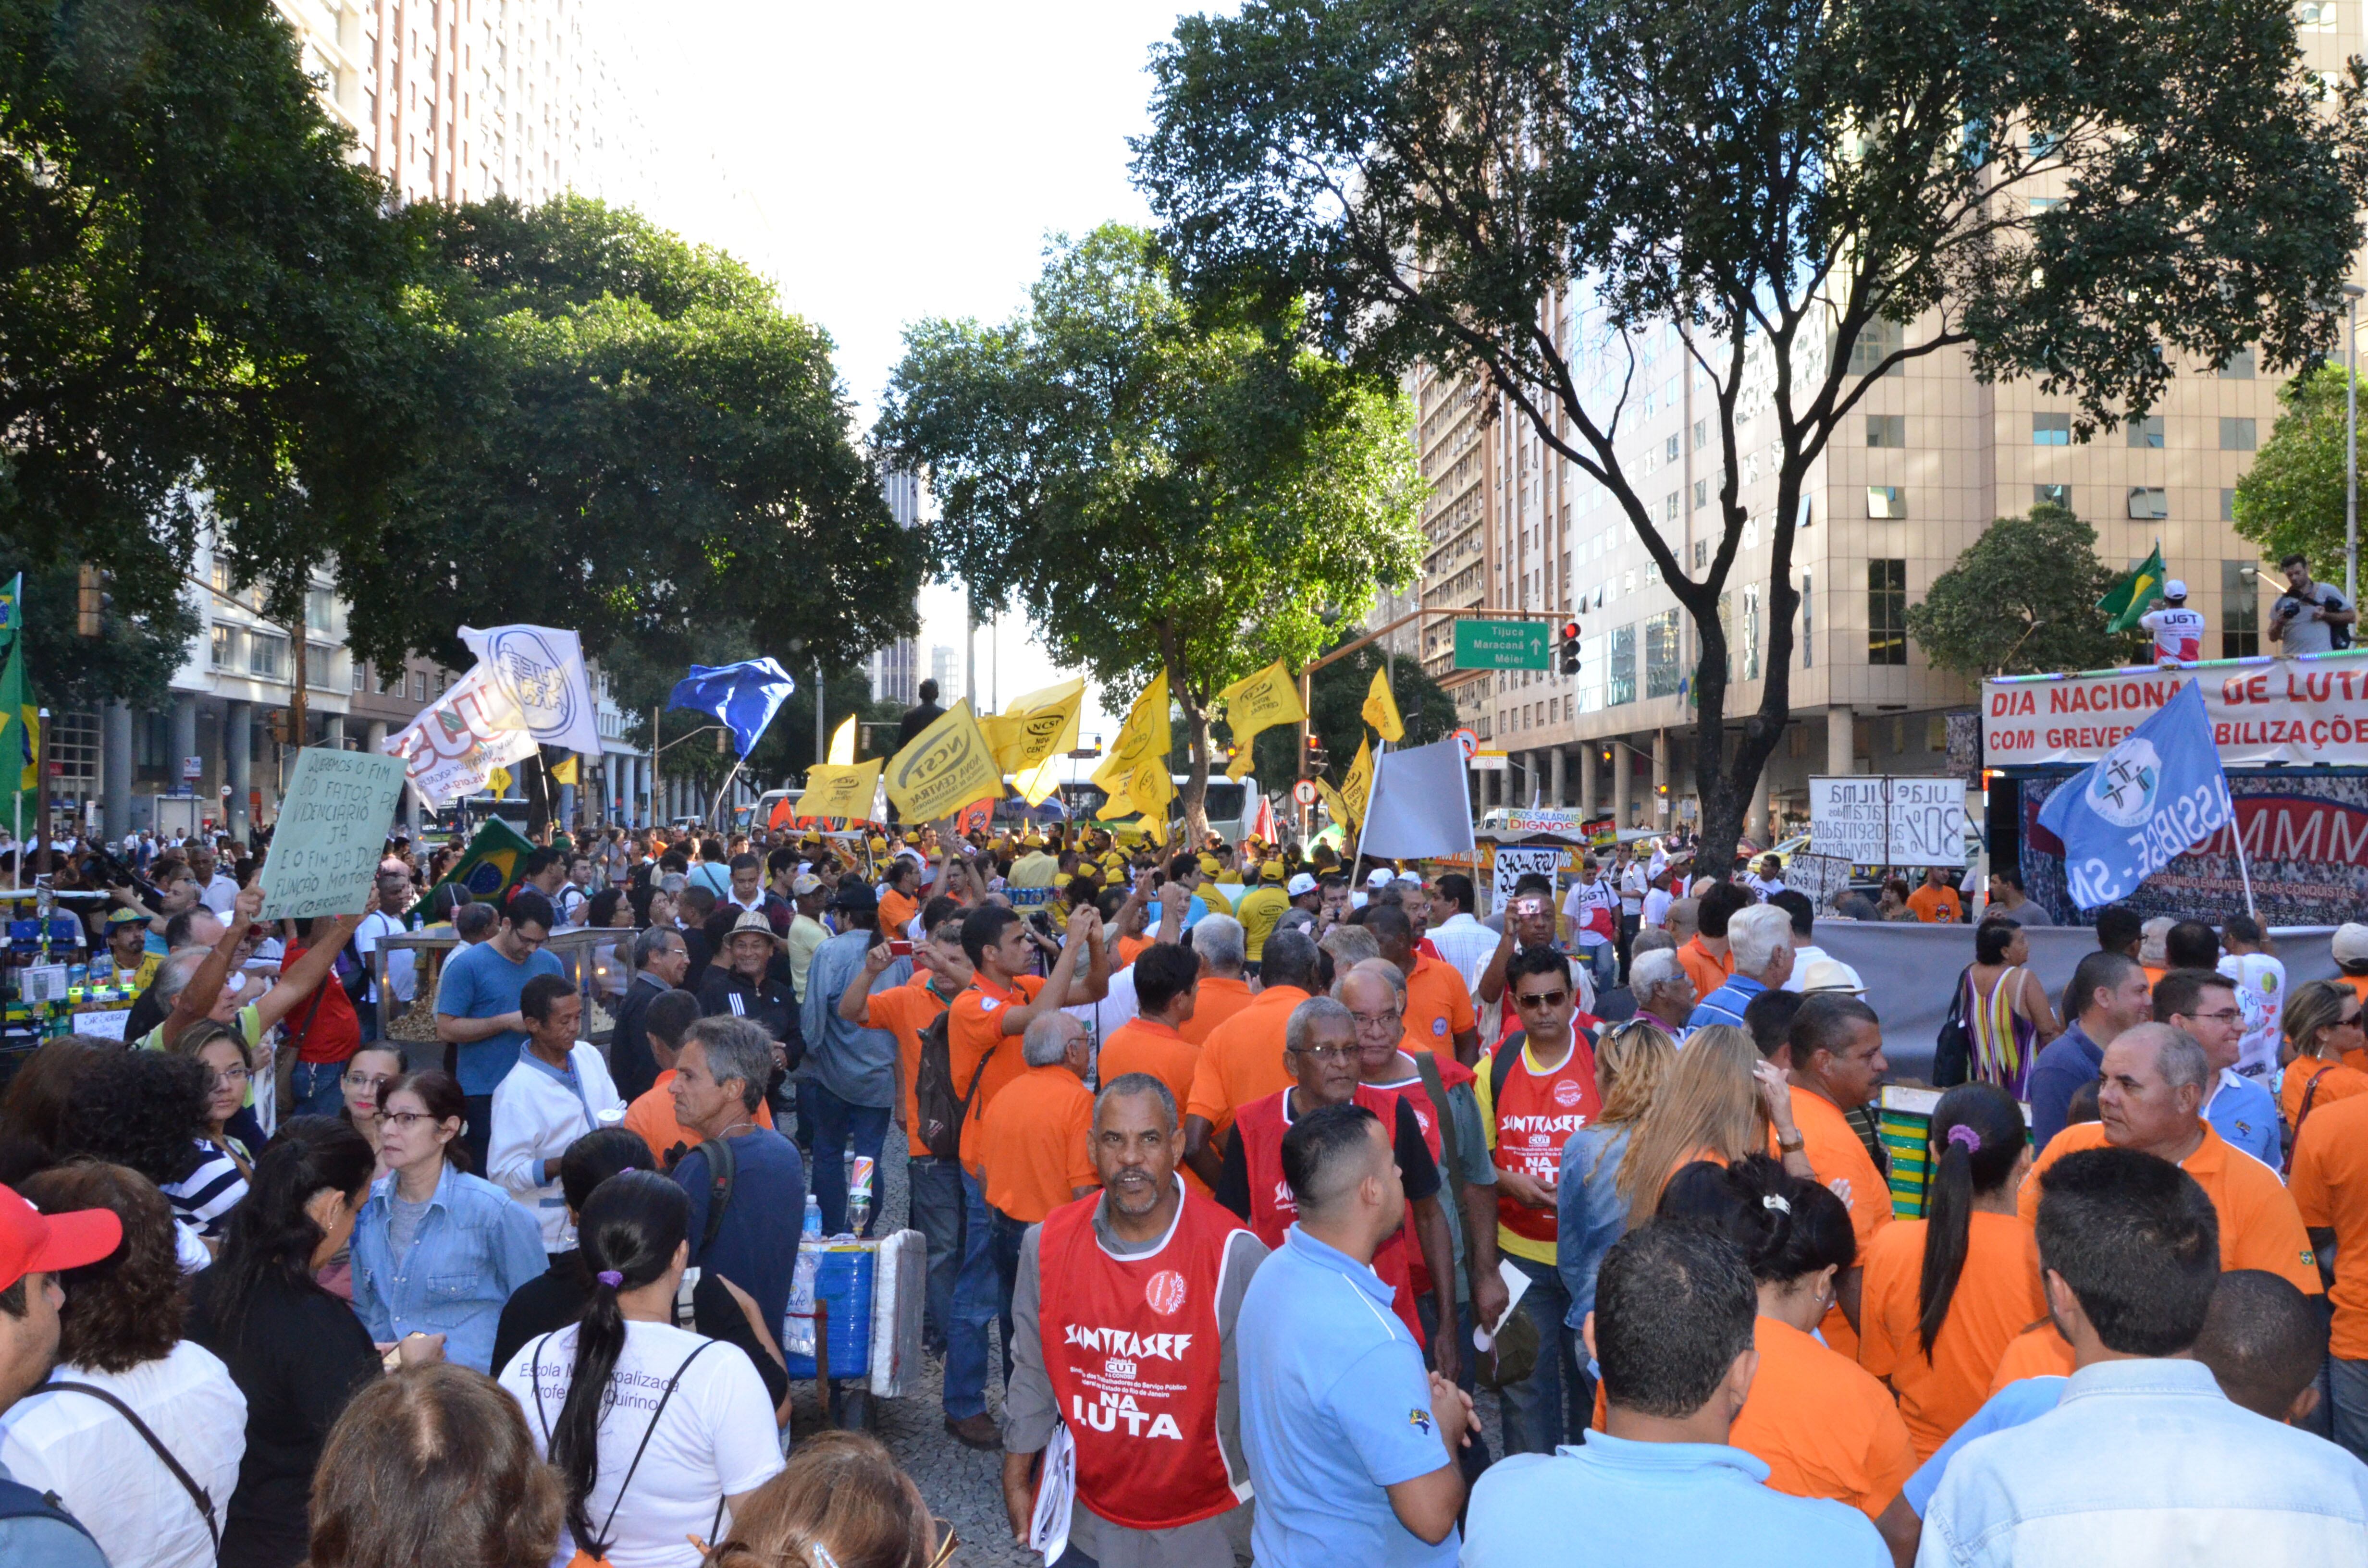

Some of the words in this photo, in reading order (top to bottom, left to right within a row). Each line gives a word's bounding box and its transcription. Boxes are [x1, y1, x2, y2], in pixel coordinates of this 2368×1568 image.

[2165, 614, 2197, 624] UGT
[1492, 626, 1524, 637] Tijuca
[1474, 639, 1524, 649] Maracanã
[1495, 654, 1524, 663] Méier
[1991, 690, 2035, 717] DIA
[2050, 680, 2206, 714] NACIONA
[2222, 675, 2269, 705] DE
[1990, 729, 2035, 750] COM
[308, 753, 353, 774] QUEREMOS
[356, 761, 365, 775] O
[368, 763, 391, 783] FIM
[324, 781, 373, 805] FATOR
[1509, 809, 1532, 820] PISOS
[1535, 811, 1580, 822] SALARIAIS
[1509, 819, 1576, 832] DIGNOS
[280, 849, 289, 870] E
[293, 851, 303, 868] O
[308, 850, 328, 868] FIM
[332, 849, 352, 870] DA
[1497, 852, 1557, 874] CACHORRO
[1558, 851, 1573, 868] DOG
[273, 871, 320, 900] FUNÇÃO
[2210, 878, 2266, 893] MANTEDO
[296, 893, 353, 915] COBRADOR
[1500, 1115, 1587, 1134] SINTRASEF
[1526, 1156, 1553, 1167] NA
[1064, 1323, 1194, 1361] SINTRASEF
[519, 1362, 560, 1377] Escola
[1107, 1363, 1135, 1372] CUT
[1097, 1374, 1134, 1387] Trabalhadores
[1142, 1382, 1164, 1391] Serviço
[1101, 1384, 1121, 1393] Estado
[604, 1384, 659, 1411] Quirino
[1100, 1391, 1139, 1411] NA
[1073, 1395, 1183, 1440] LUTA
